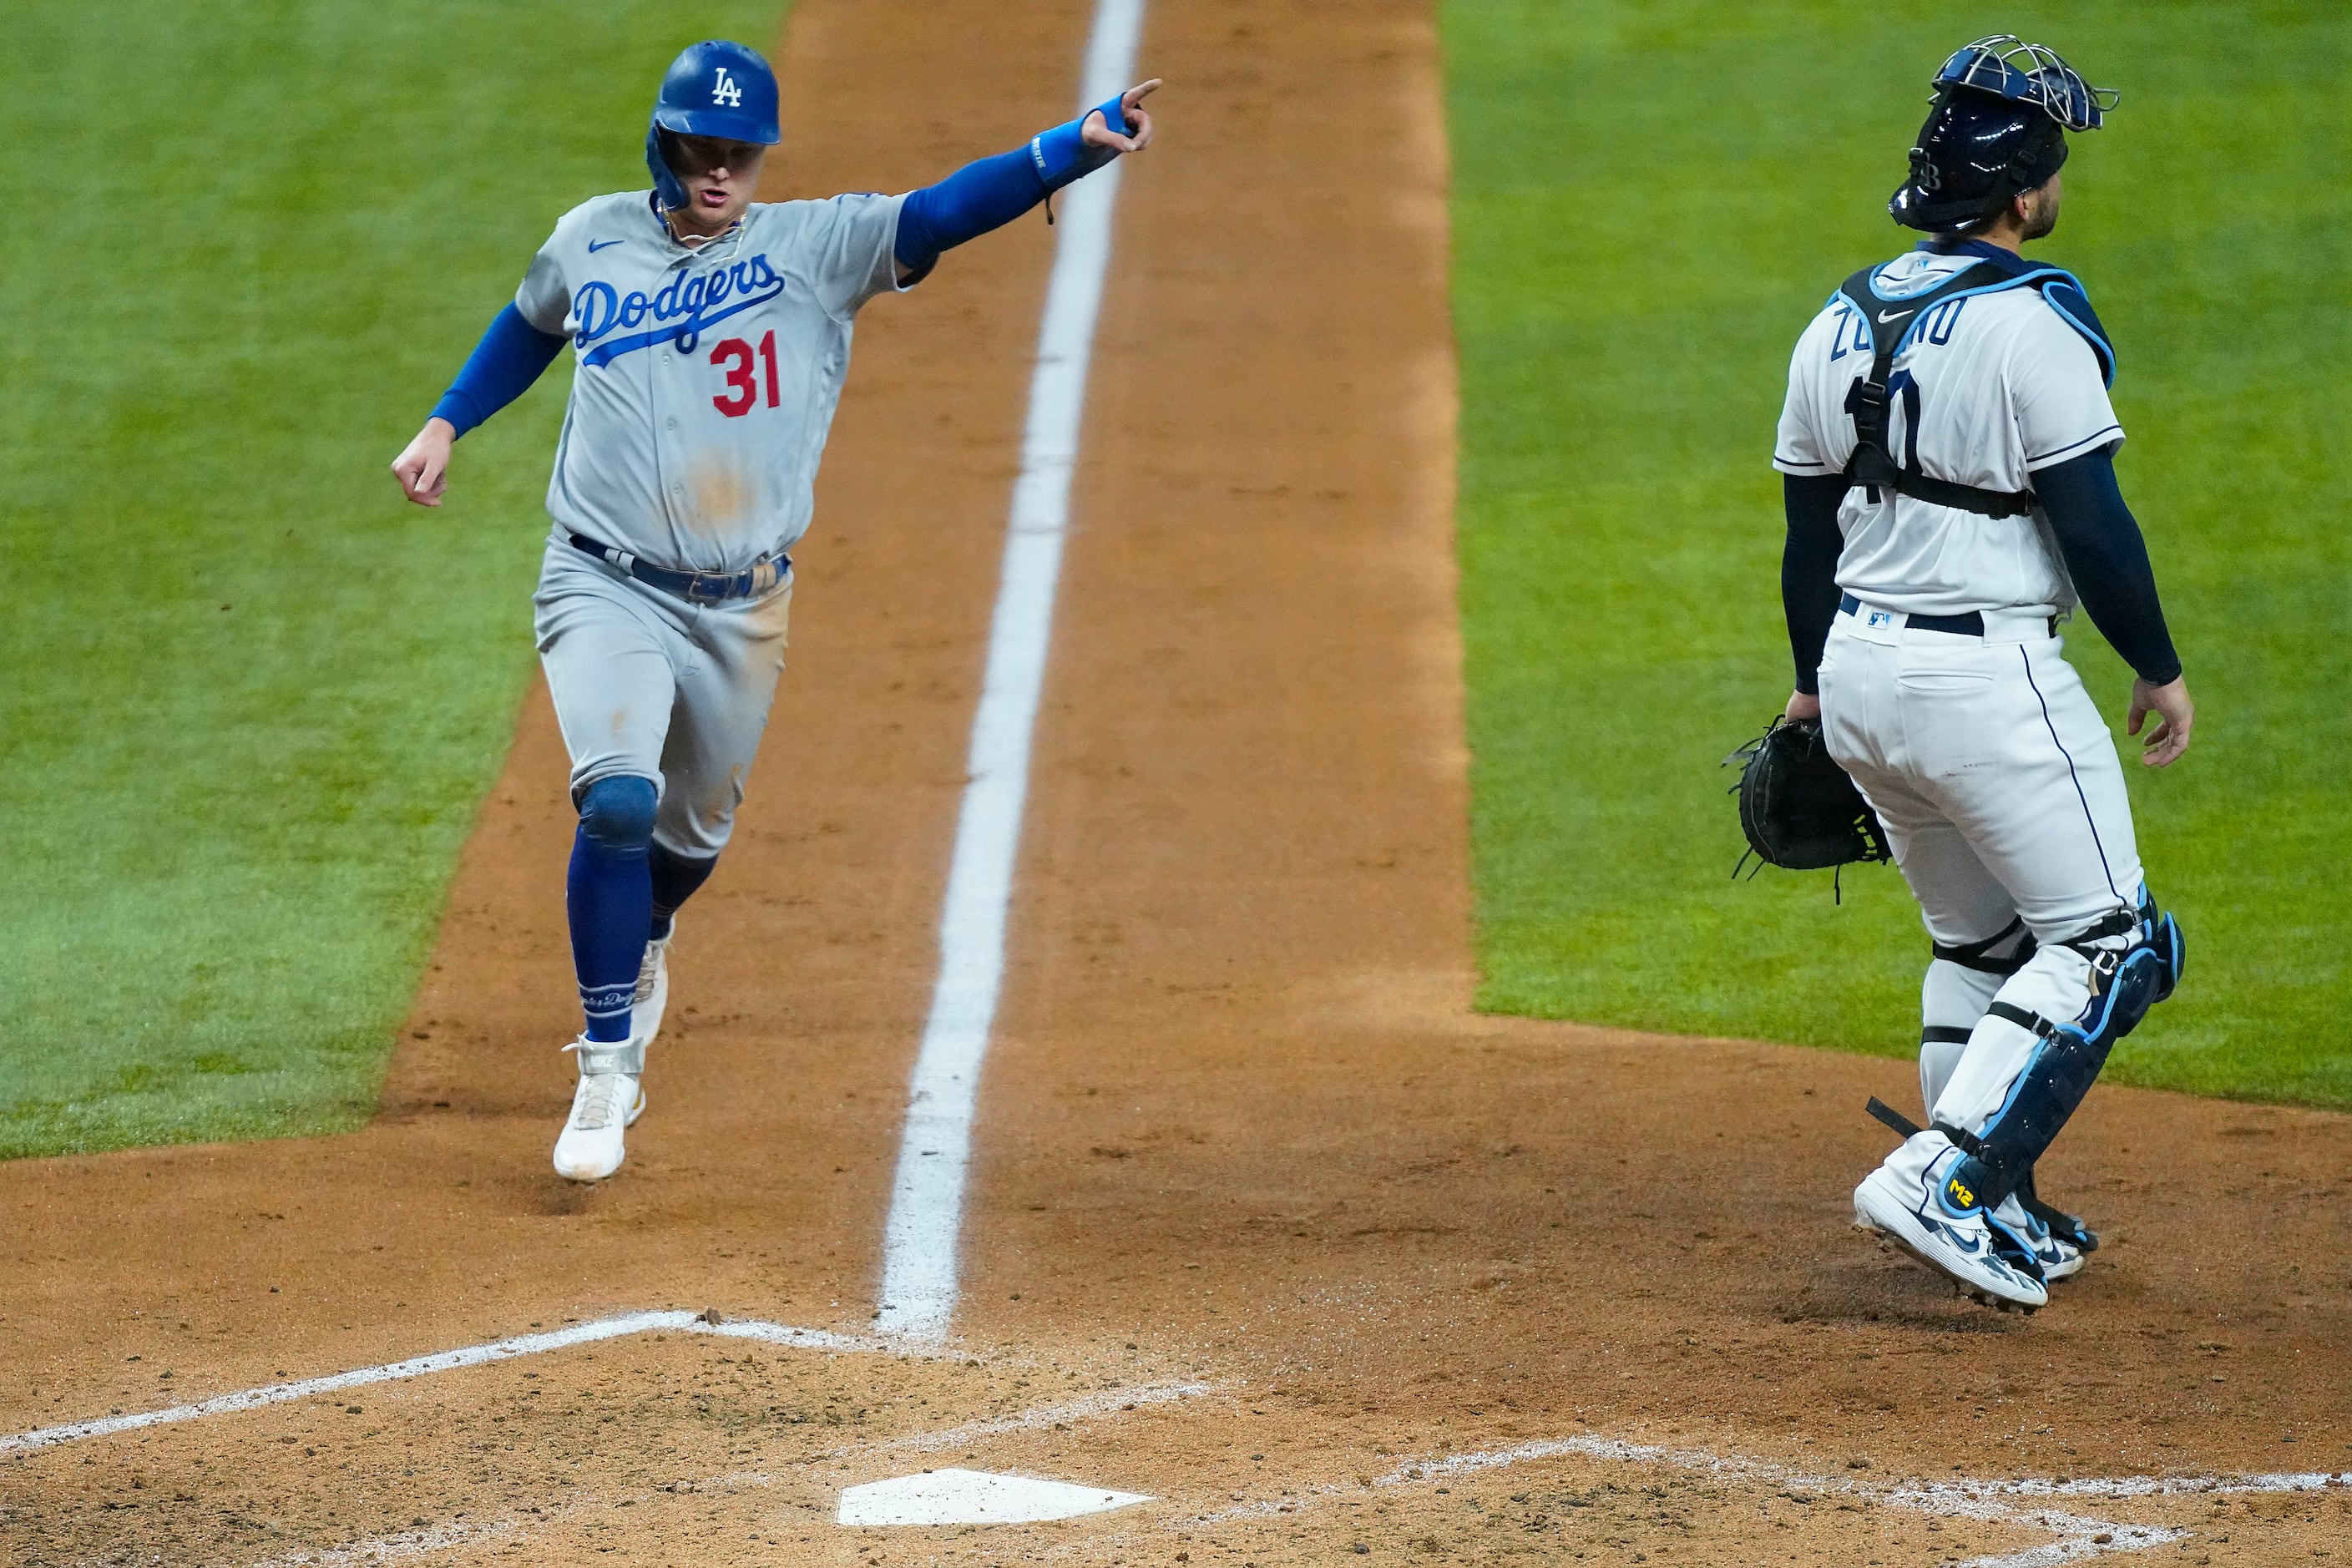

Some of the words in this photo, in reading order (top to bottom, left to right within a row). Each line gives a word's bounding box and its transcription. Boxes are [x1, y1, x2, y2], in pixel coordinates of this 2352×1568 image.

[712, 67, 742, 107] LA
[574, 252, 785, 356] Dodgers
[709, 328, 781, 417] 31
[589, 1055, 615, 1068] NIKE
